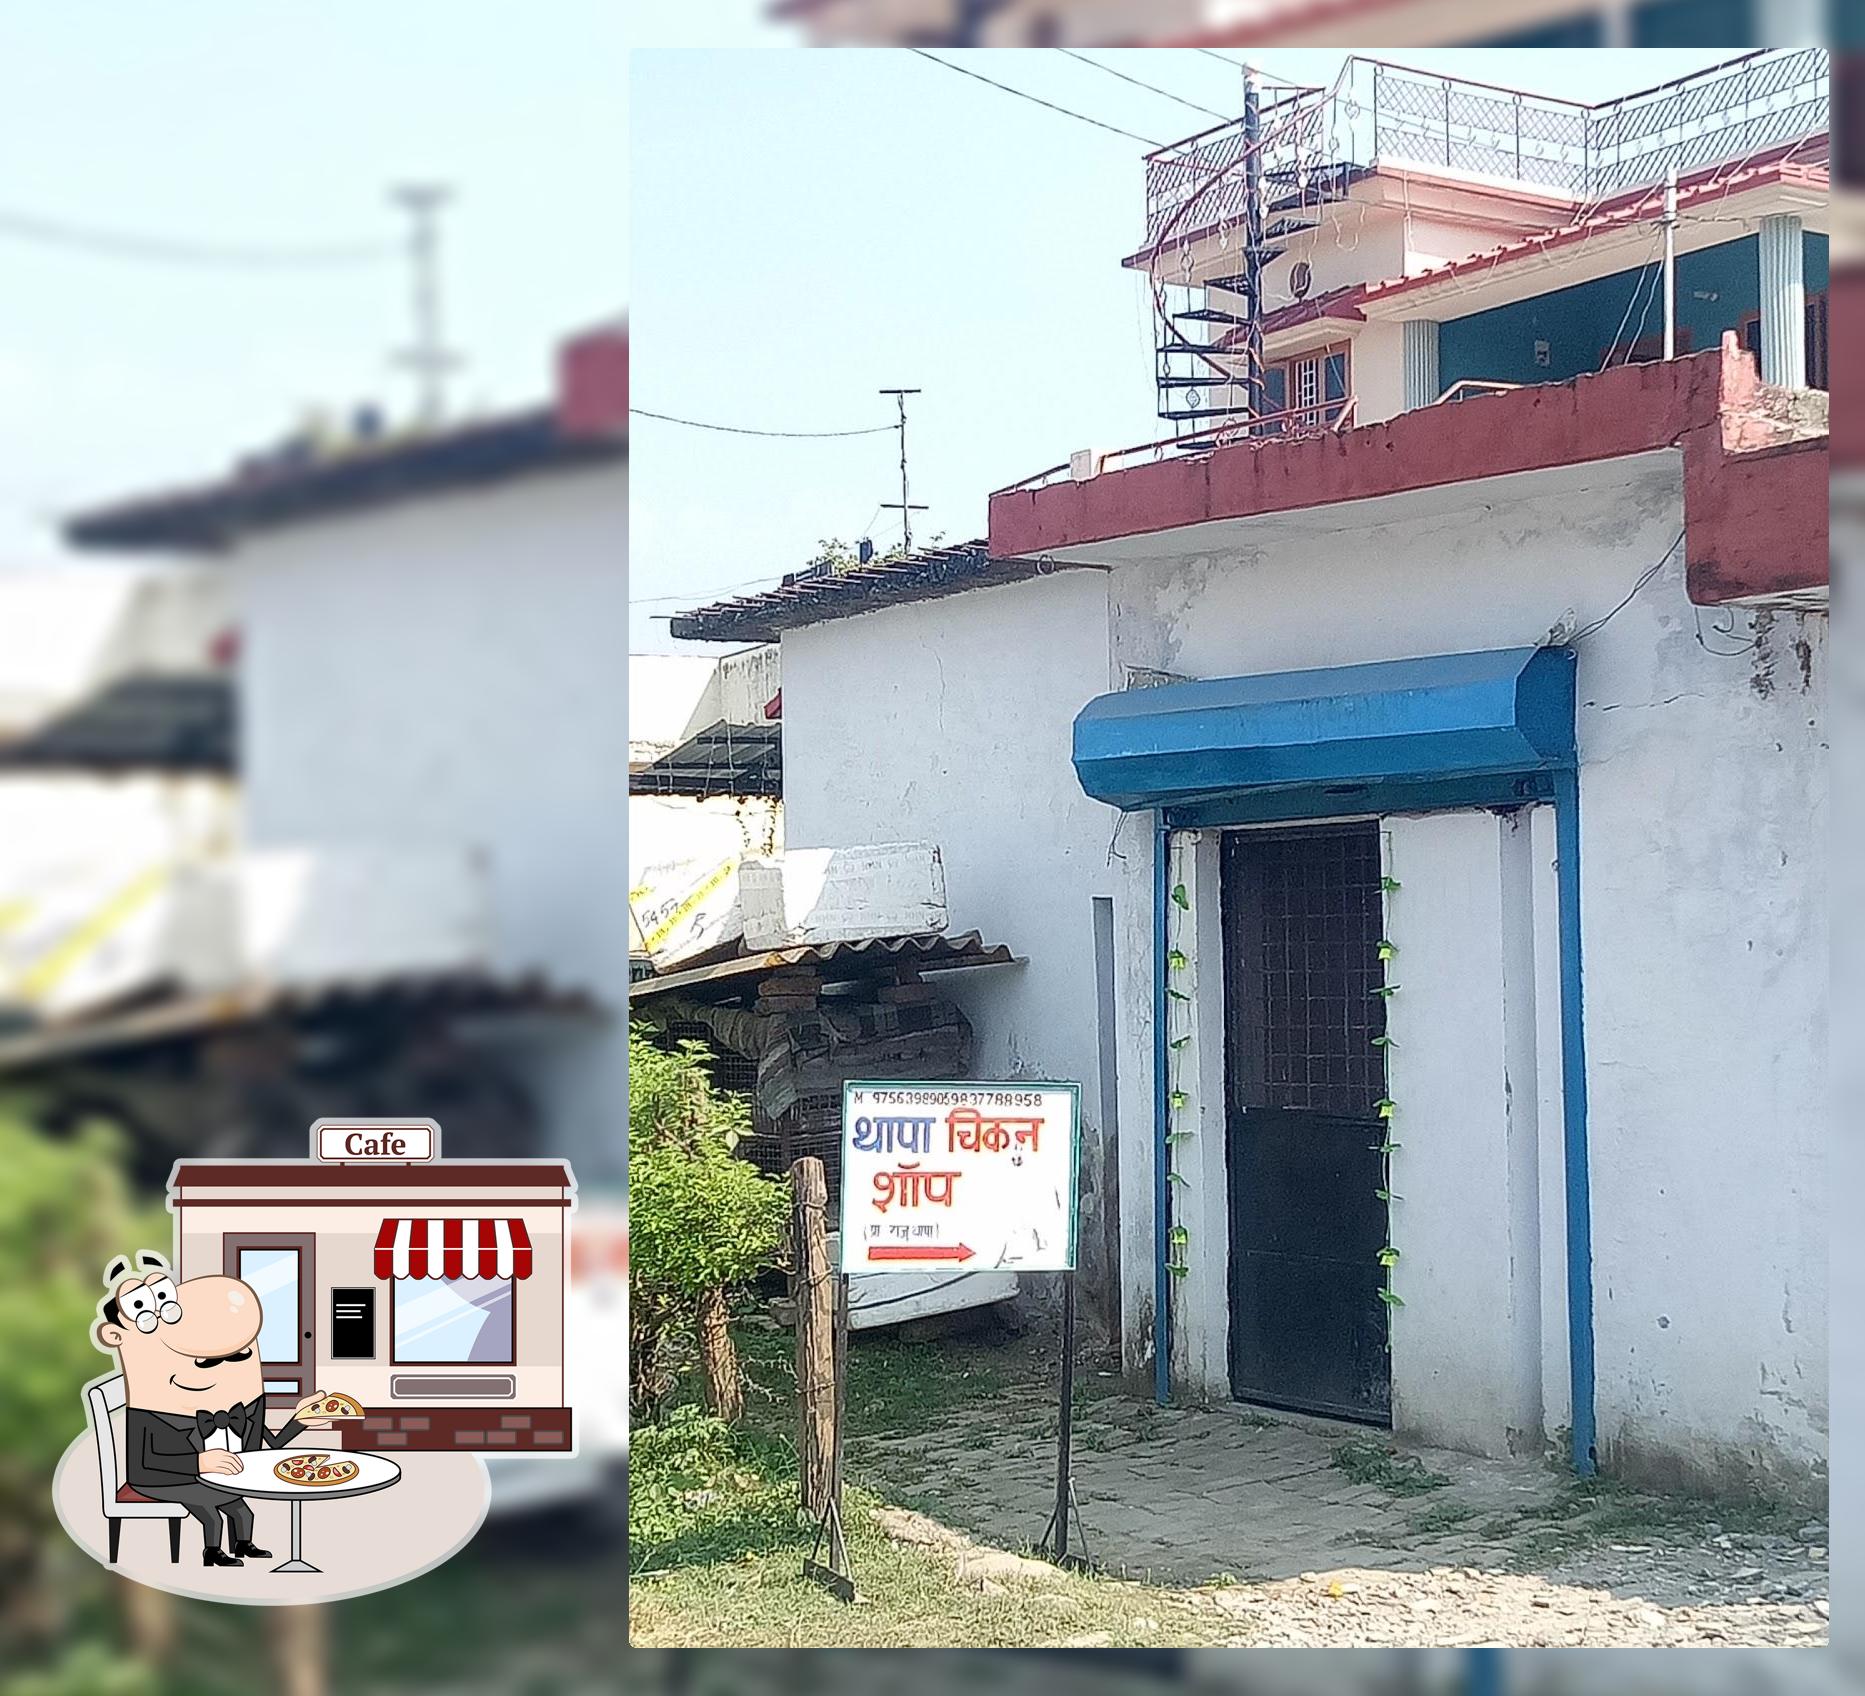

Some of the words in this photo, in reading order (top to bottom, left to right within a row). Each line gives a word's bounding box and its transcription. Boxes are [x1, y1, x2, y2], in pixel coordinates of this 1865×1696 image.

[852, 1116, 936, 1153] थापा
[945, 1107, 1045, 1153] चिकन
[871, 1162, 962, 1213] शॉप
